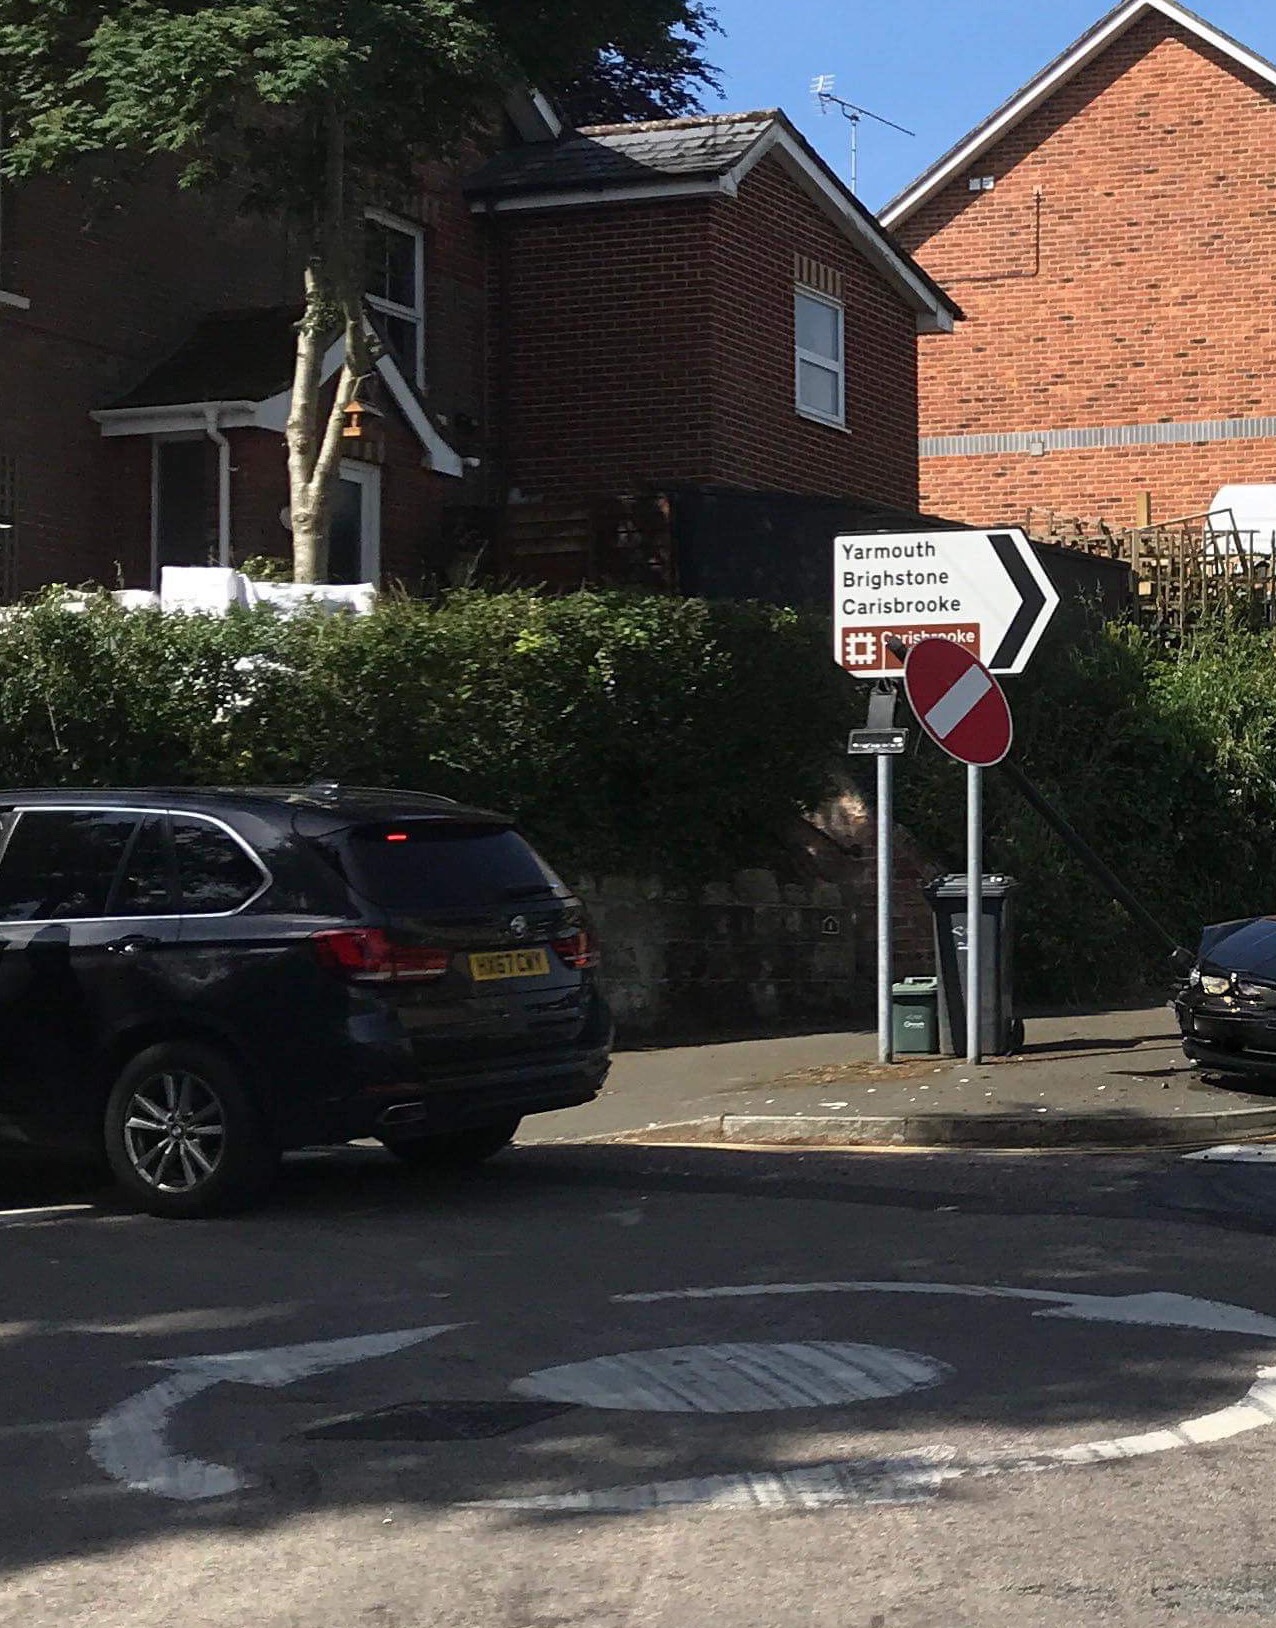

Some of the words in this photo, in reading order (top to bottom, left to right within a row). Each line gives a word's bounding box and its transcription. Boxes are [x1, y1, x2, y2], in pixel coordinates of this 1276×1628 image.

[842, 541, 936, 560] Yarmouth
[843, 570, 949, 590] Brighstone
[842, 596, 961, 615] Carisbrooke
